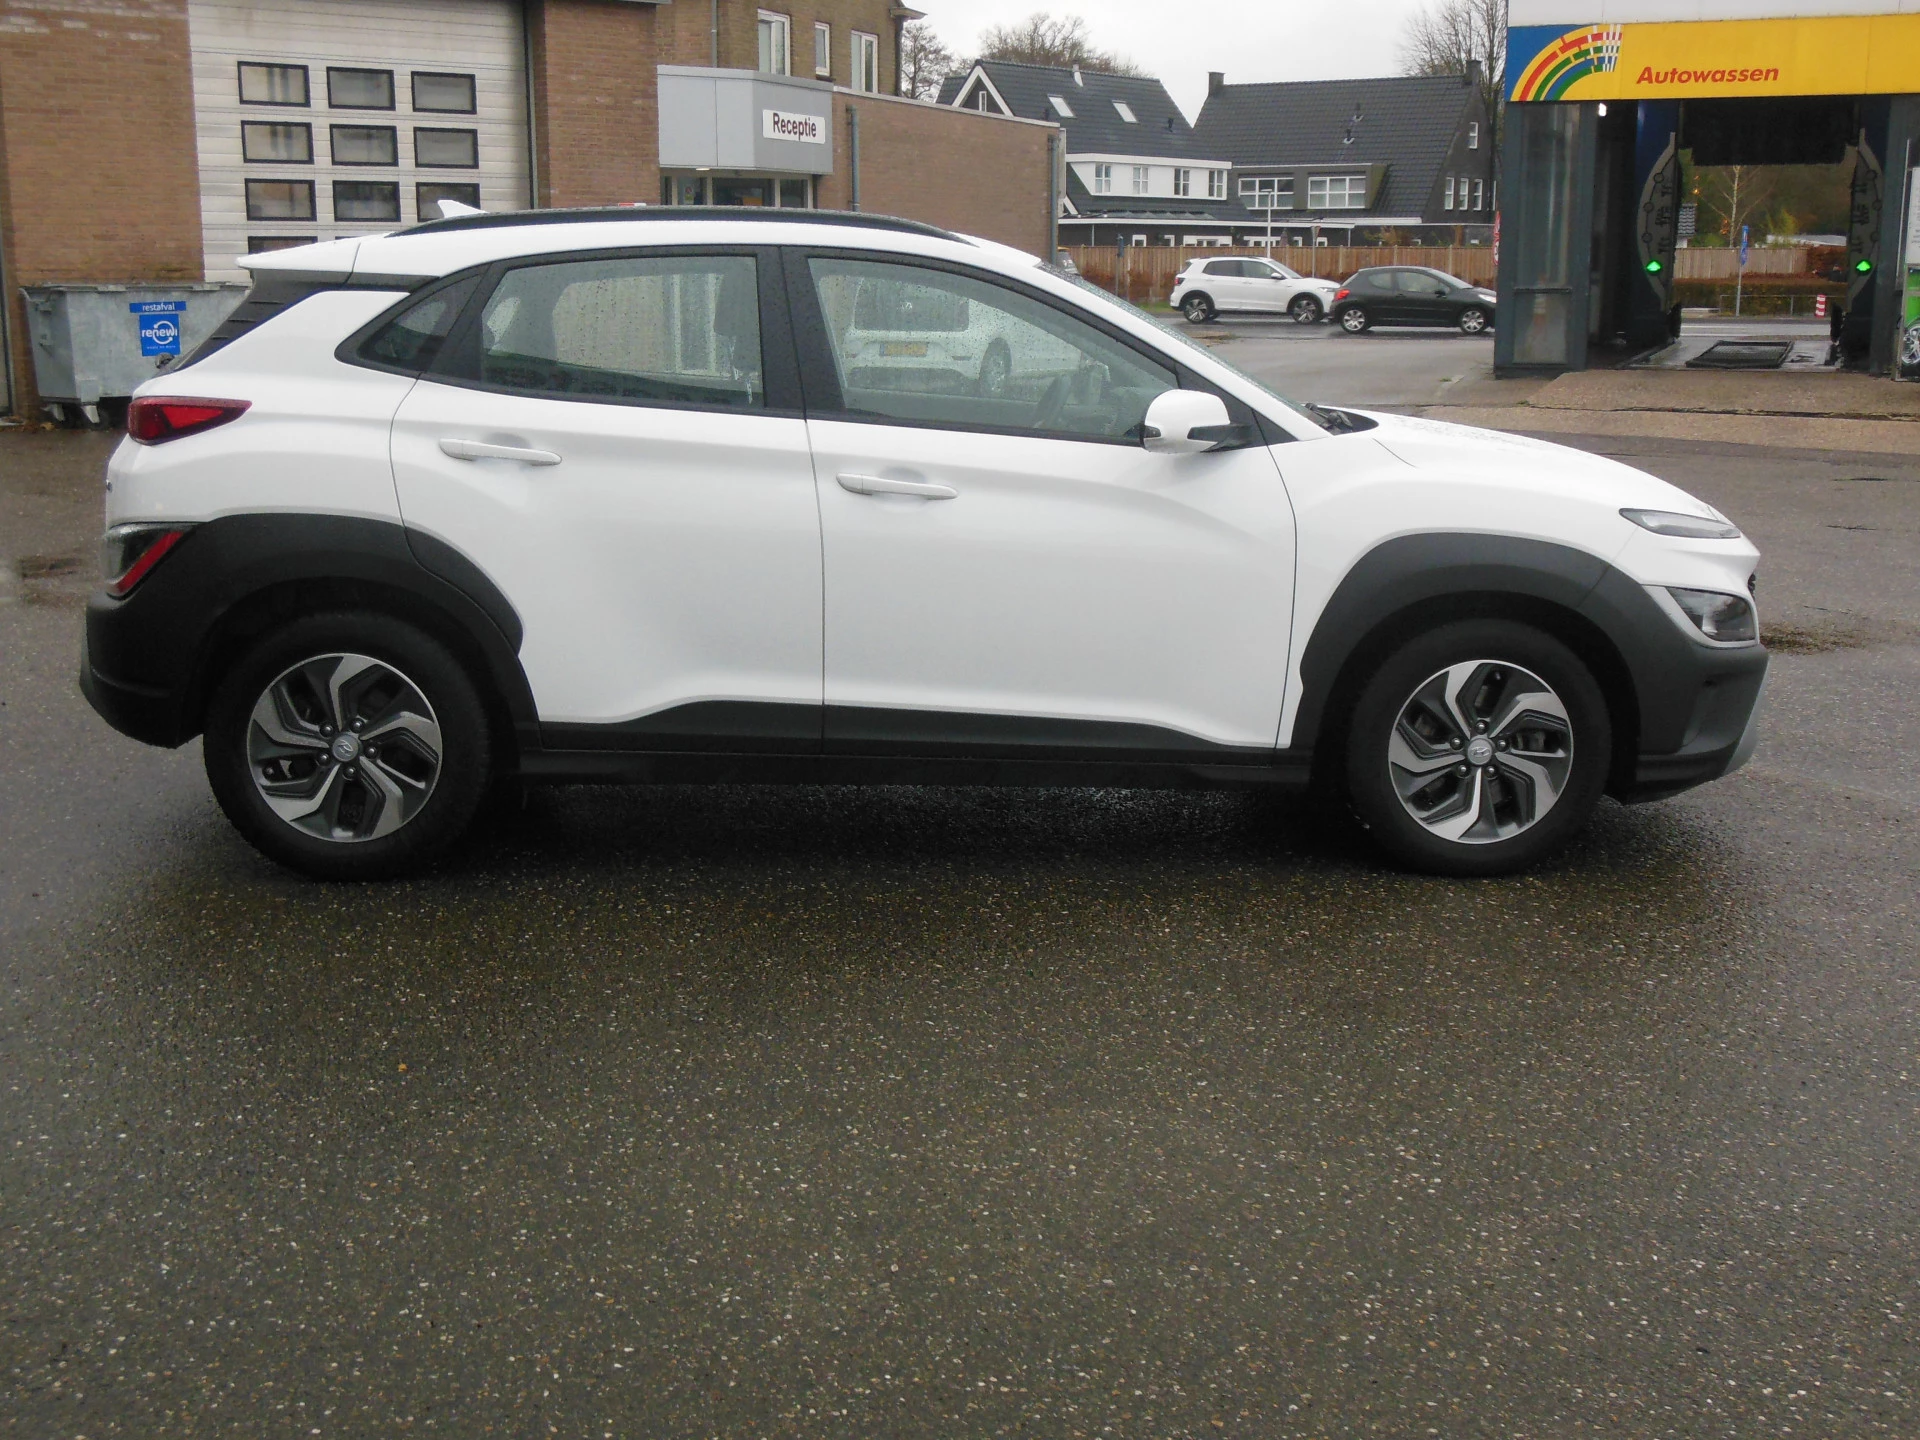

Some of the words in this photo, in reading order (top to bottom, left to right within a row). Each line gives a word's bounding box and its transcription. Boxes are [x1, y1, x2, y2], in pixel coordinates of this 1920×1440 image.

[1636, 66, 1780, 85] Autowassen
[772, 111, 817, 142] Receptie
[142, 301, 176, 312] restafval
